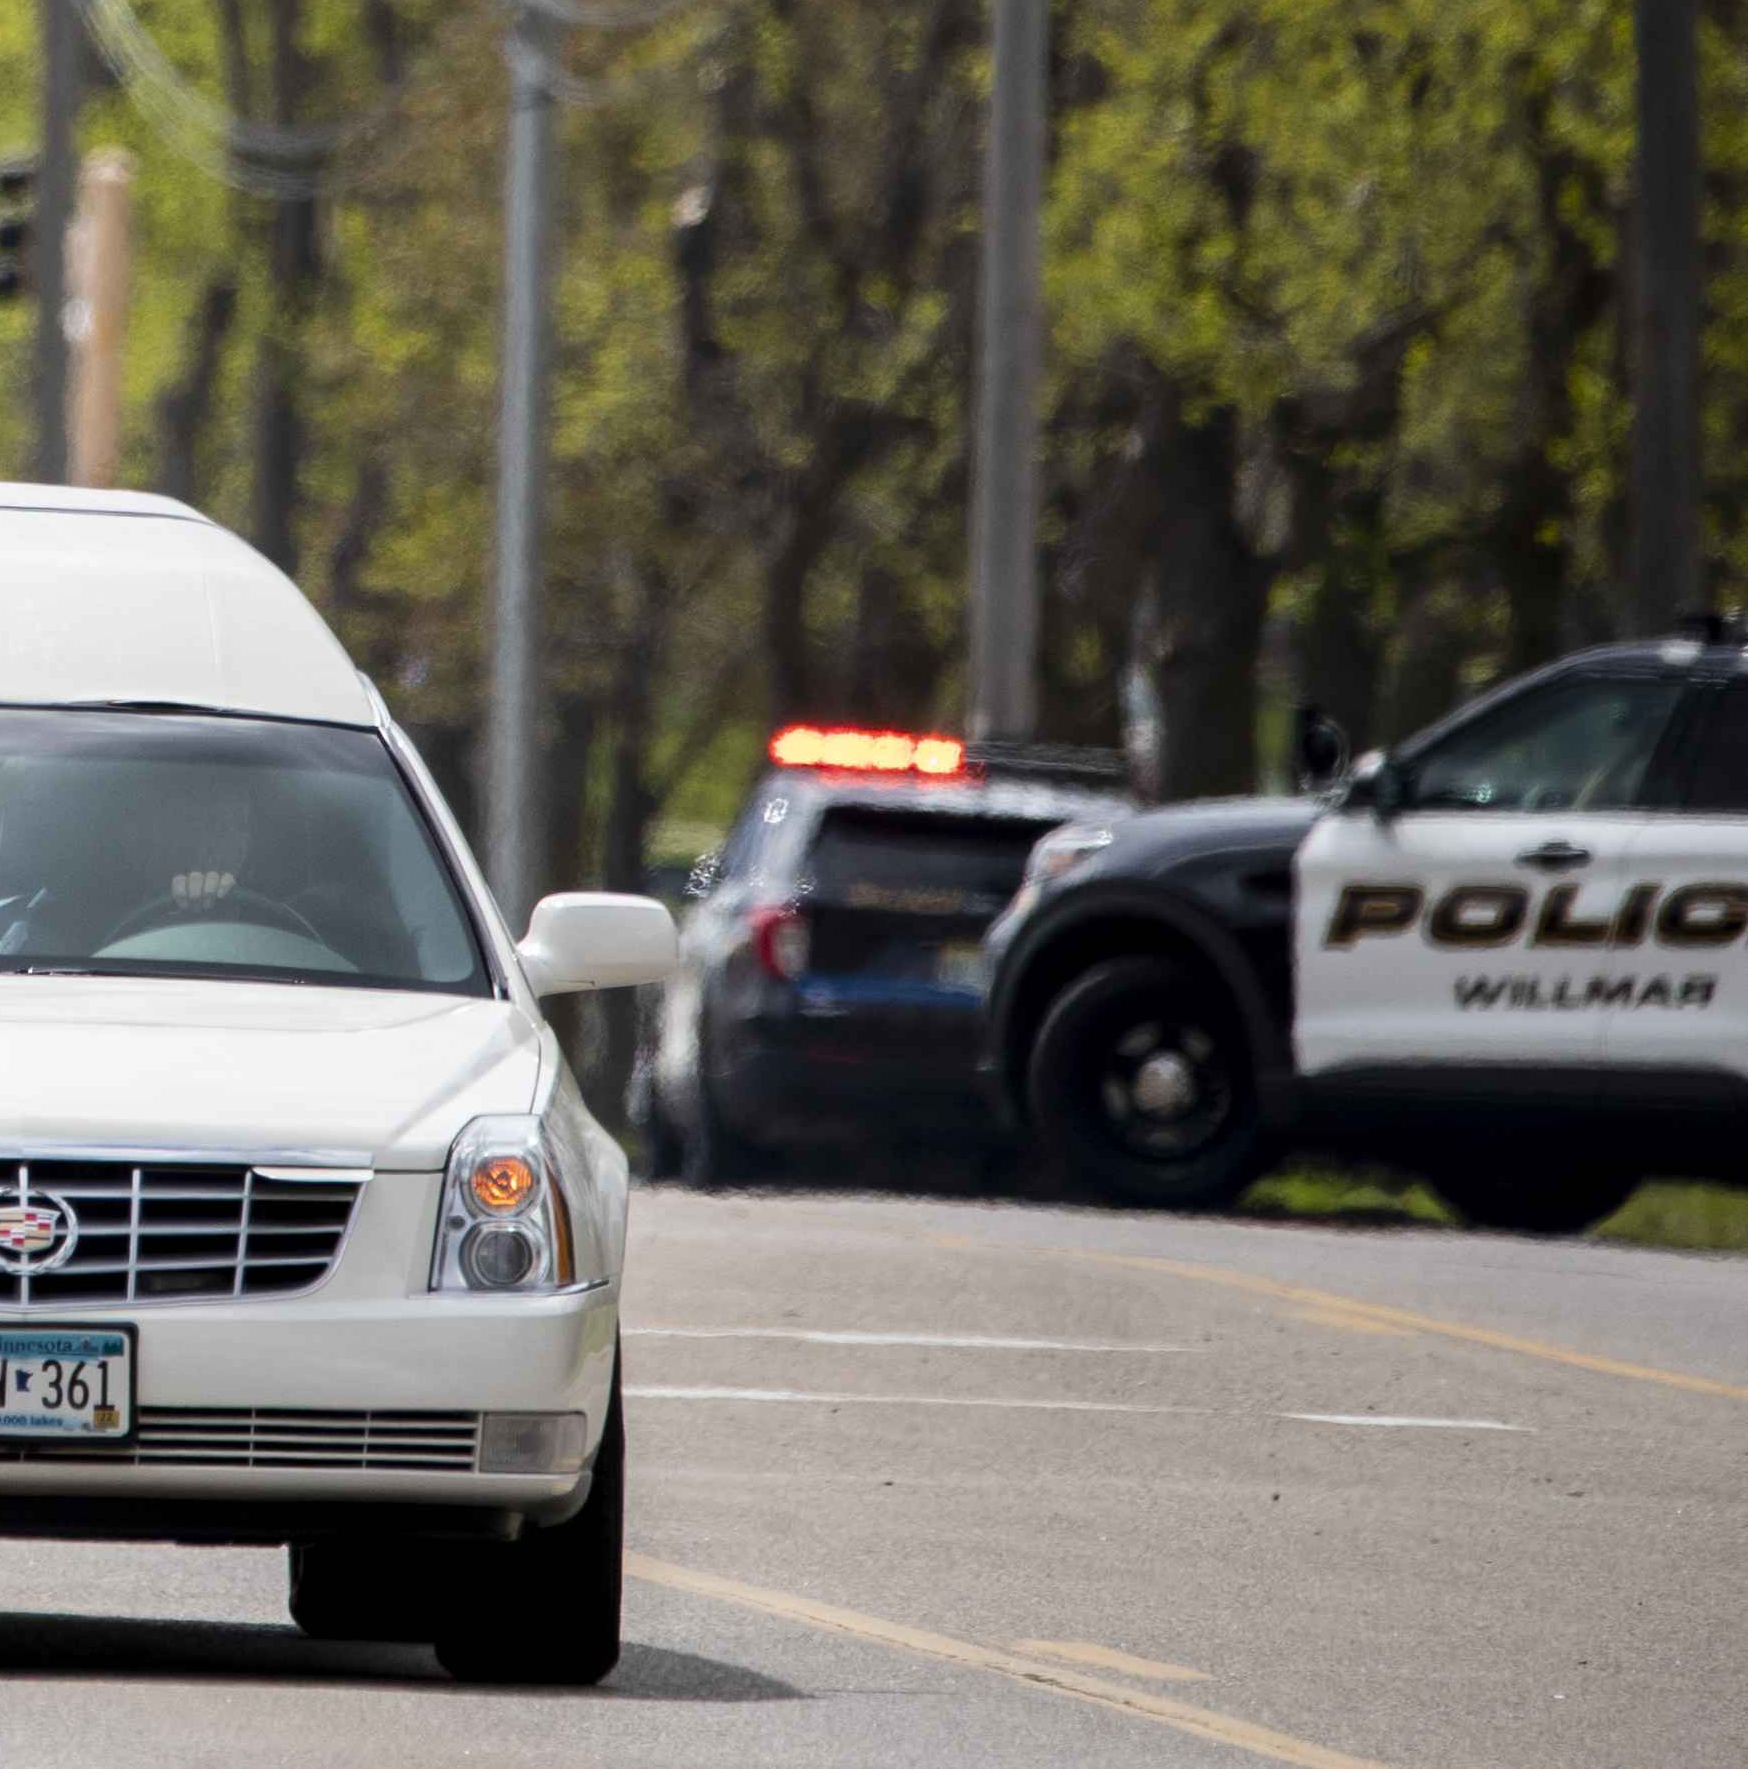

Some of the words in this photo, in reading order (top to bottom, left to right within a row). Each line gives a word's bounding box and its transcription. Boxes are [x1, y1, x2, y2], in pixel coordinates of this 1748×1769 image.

[1323, 883, 1748, 950] POLIC
[1453, 974, 1718, 1011] WILLMAR
[41, 1358, 116, 1410] 361
[29, 1414, 64, 1428] lakes
